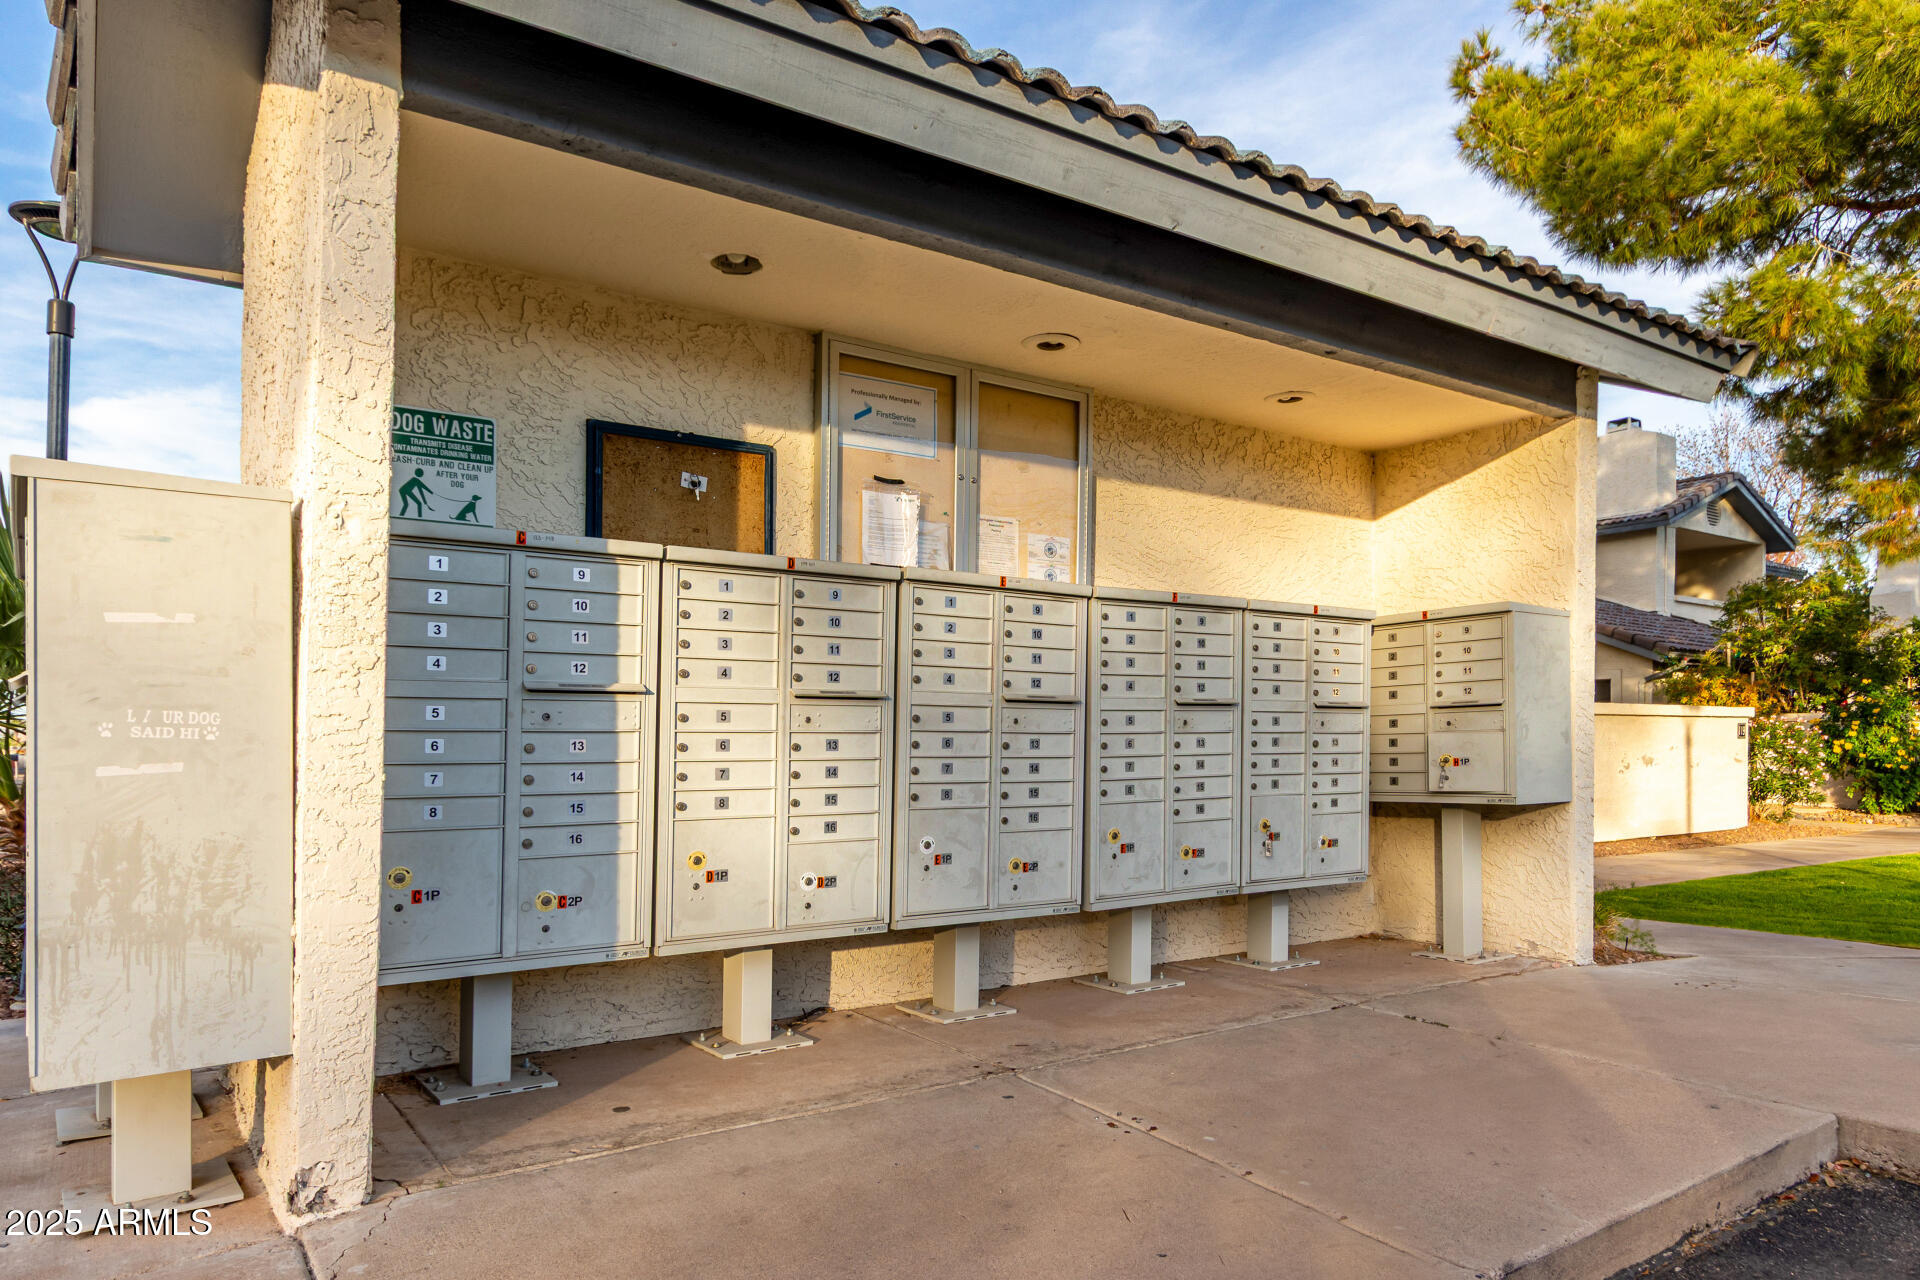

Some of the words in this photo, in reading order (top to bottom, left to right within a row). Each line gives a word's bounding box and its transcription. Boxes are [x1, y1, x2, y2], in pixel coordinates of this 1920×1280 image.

[851, 388, 888, 400] Professionally
[889, 395, 912, 404] Managed
[876, 410, 916, 423] FirstService
[432, 417, 493, 442] WASTE
[410, 437, 446, 448] TRANSMITS
[448, 442, 472, 452] DISEASE
[392, 444, 439, 456] ONTAMINATES
[440, 449, 468, 459] DRINKING
[470, 454, 492, 462] WATER
[439, 460, 454, 469] AND
[458, 462, 481, 472] CLEAN
[436, 470, 458, 479] AFTER
[460, 473, 479, 481] YOUR
[518, 531, 524, 544] C
[436, 558, 442, 569] 1
[788, 557, 794, 569] D
[578, 570, 585, 580] 9
[724, 582, 729, 591] 1
[1001, 576, 1005, 587] E
[434, 591, 442, 602] 2
[832, 590, 838, 600] 9
[575, 601, 588, 611] 10
[949, 598, 953, 606] 1
[723, 610, 729, 620] 2
[1035, 606, 1040, 614] 9
[830, 618, 840, 627] 10
[434, 624, 441, 635] 3
[948, 624, 953, 632] 2
[574, 632, 586, 642] 11
[1033, 630, 1042, 639] 10
[722, 639, 728, 649] 3
[830, 645, 840, 654] 11
[947, 649, 952, 658] 3
[432, 658, 441, 668] 4
[1033, 655, 1041, 663] 11
[573, 663, 586, 673] 12
[721, 668, 728, 678] 4
[829, 673, 839, 682] 12
[946, 675, 952, 684] 4
[1032, 680, 1040, 688] 12
[162, 710, 184, 724] UR
[188, 711, 221, 725] DOG
[432, 708, 440, 718] 5
[720, 712, 727, 721] 5
[946, 713, 951, 722] 5
[130, 726, 175, 738] SAID
[180, 727, 200, 740] HI
[431, 741, 439, 751] 6
[571, 741, 584, 751] 13
[720, 740, 726, 750] 6
[827, 741, 838, 750] 13
[945, 739, 951, 748] 6
[1031, 740, 1040, 748] 13
[826, 768, 838, 777] 14
[945, 764, 950, 773] 7
[430, 774, 438, 784] 7
[570, 772, 584, 782] 14
[720, 769, 726, 779] 7
[944, 790, 950, 799] 8
[1030, 789, 1038, 797] 15
[719, 798, 725, 808] 8
[826, 795, 836, 804] 15
[429, 807, 437, 818] 8
[570, 803, 584, 813] 15
[826, 823, 836, 832] 16
[569, 834, 582, 844] 16
[936, 855, 940, 864] E
[942, 855, 952, 864] 1P
[1028, 863, 1038, 871] 2P
[707, 871, 712, 882] D
[715, 871, 728, 881] 1P
[818, 877, 823, 888] D
[825, 877, 836, 886] 2P
[414, 890, 420, 903] C
[424, 890, 440, 902] 1P
[559, 896, 565, 908] C
[568, 896, 582, 906] 2P
